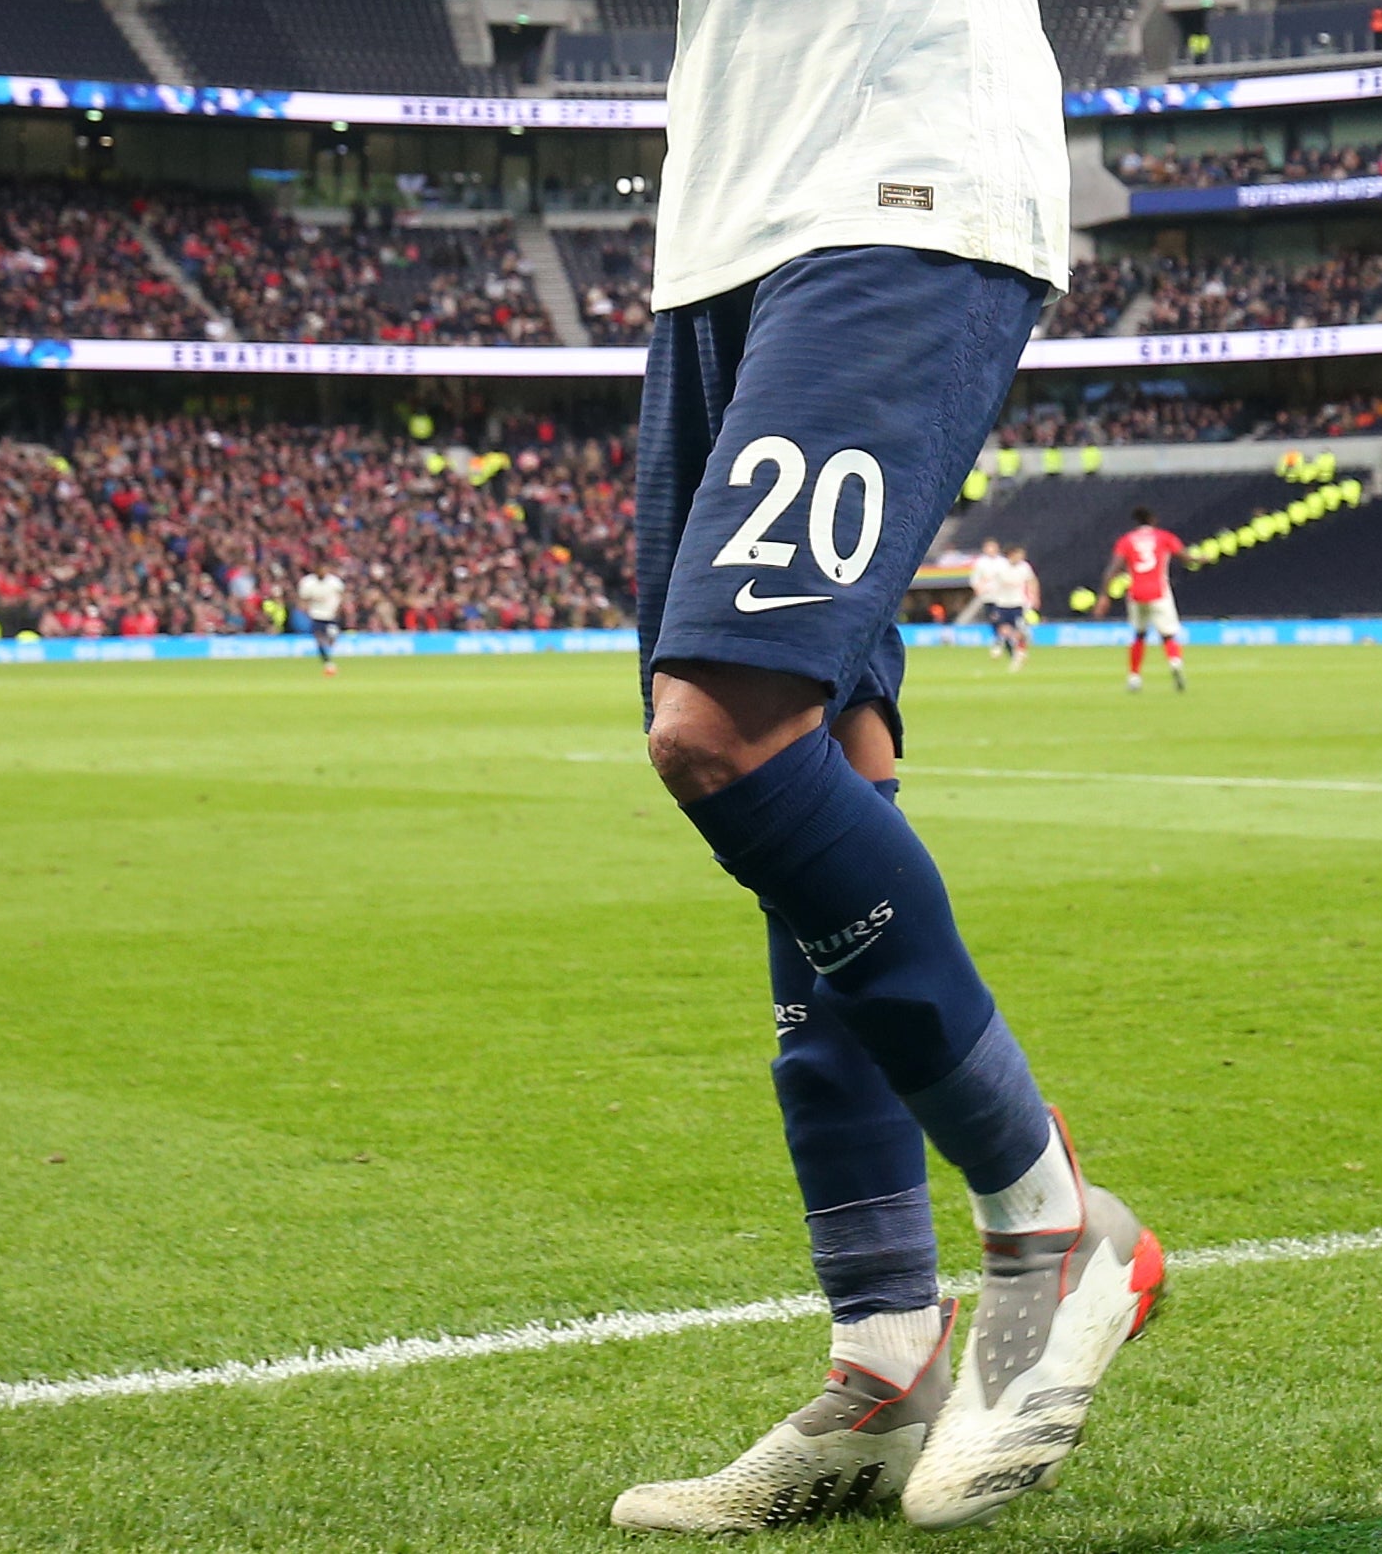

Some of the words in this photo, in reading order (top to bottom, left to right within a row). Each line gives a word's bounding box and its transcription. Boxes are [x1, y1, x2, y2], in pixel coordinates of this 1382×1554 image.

[711, 435, 886, 587] 20
[1134, 538, 1159, 574] 3
[796, 899, 895, 954] PURS
